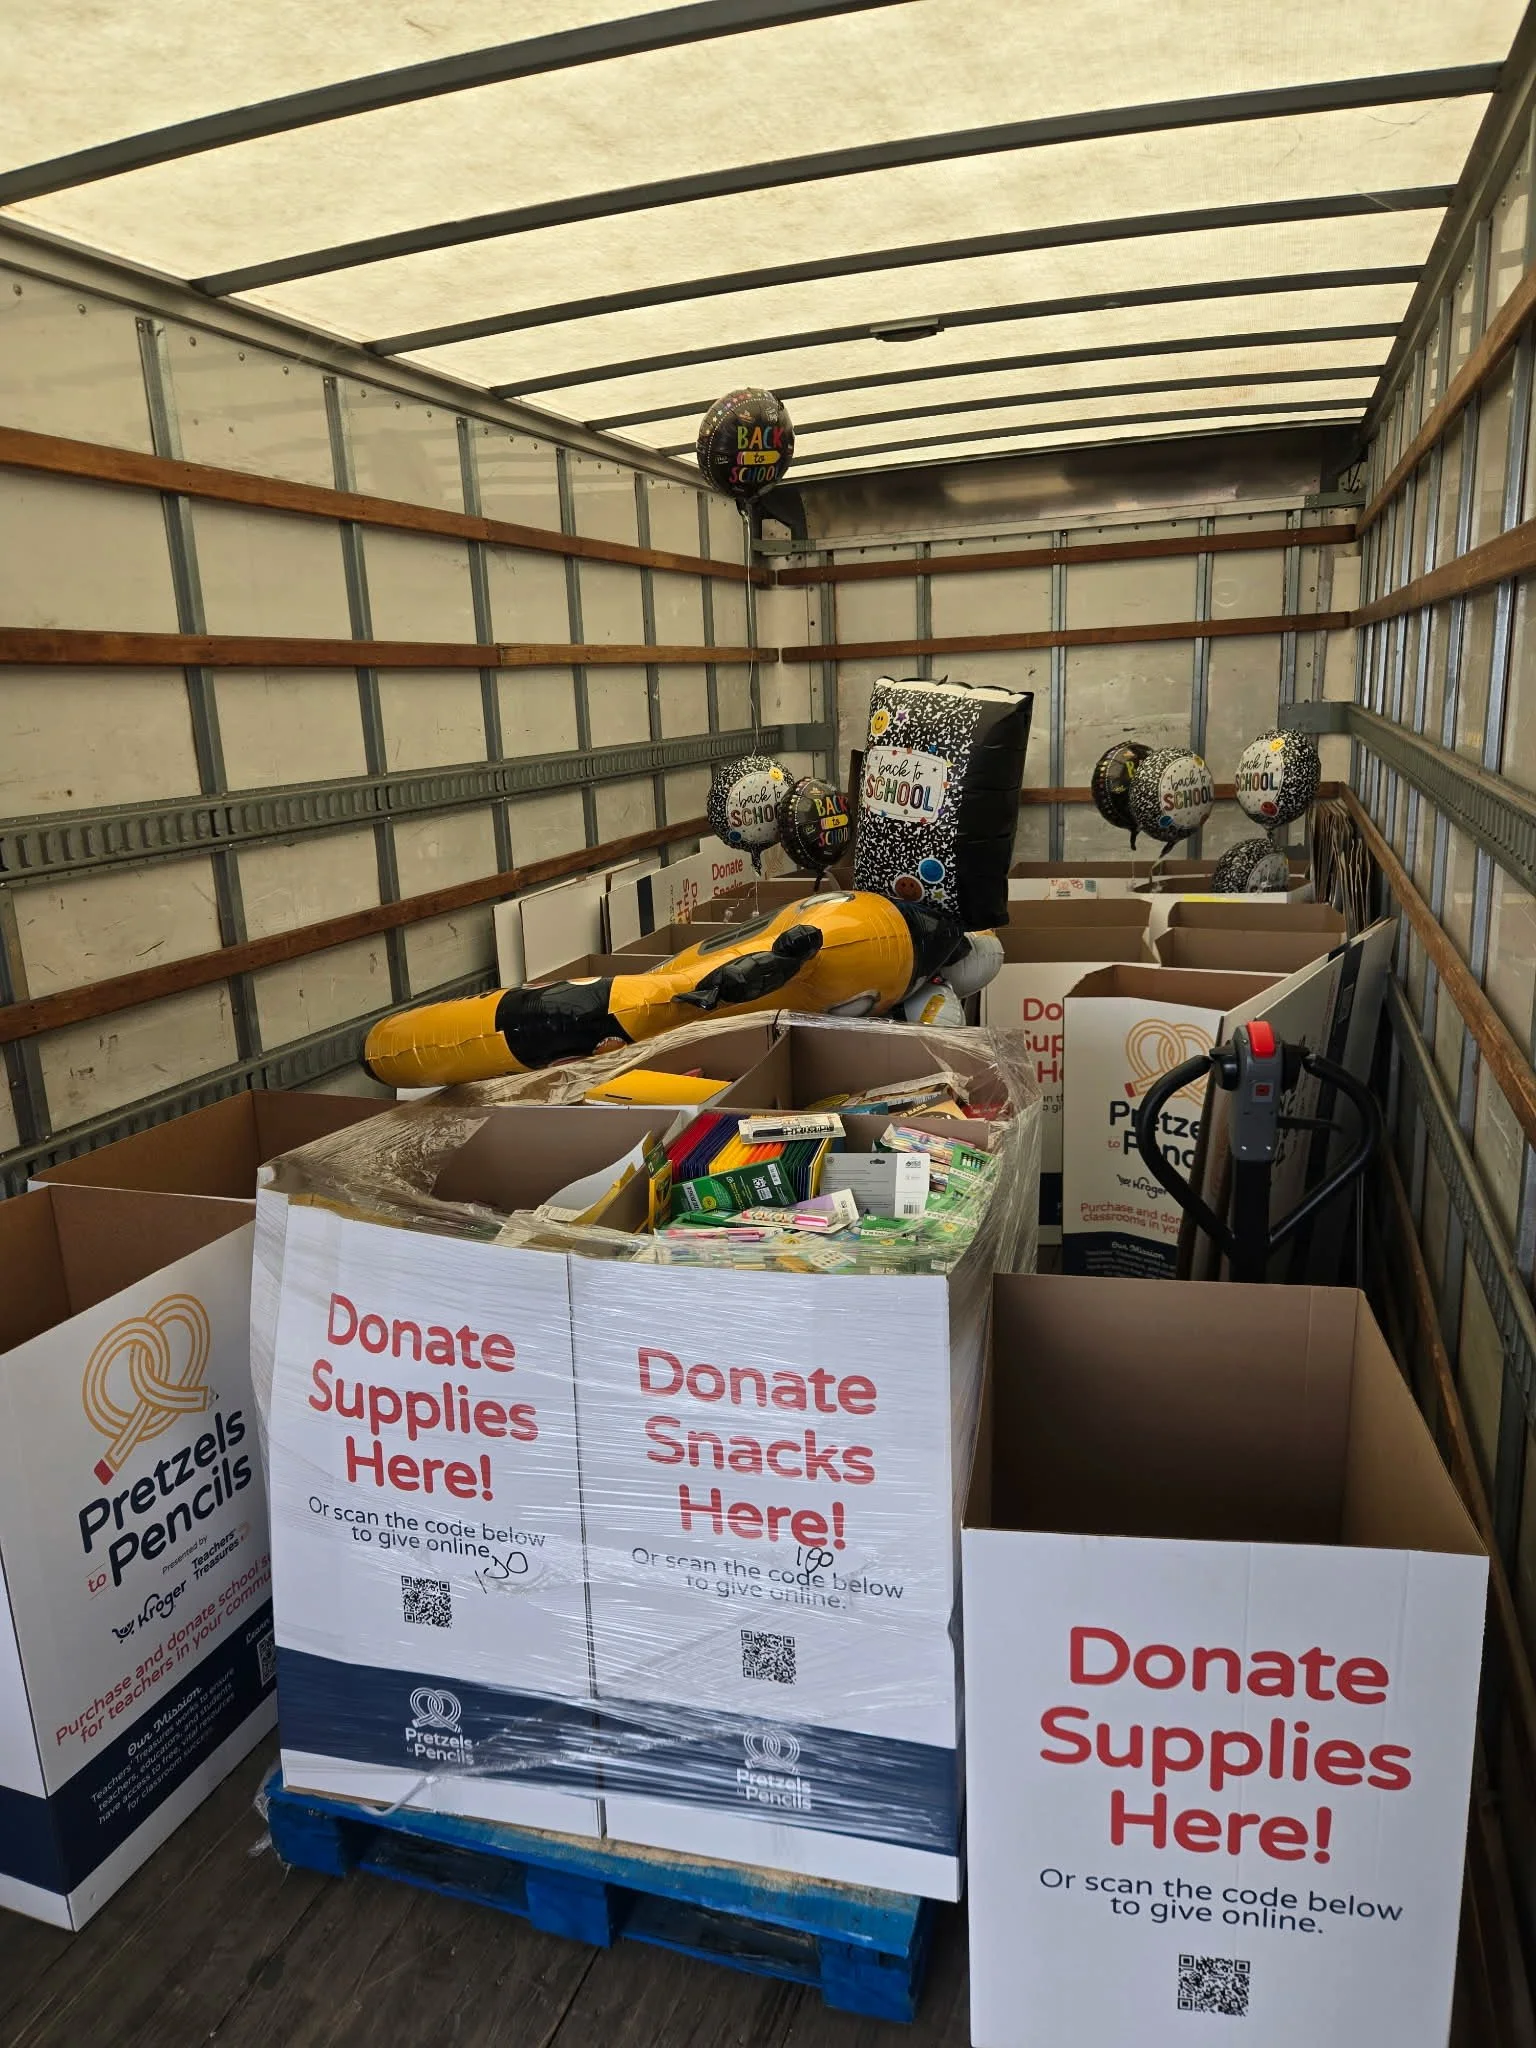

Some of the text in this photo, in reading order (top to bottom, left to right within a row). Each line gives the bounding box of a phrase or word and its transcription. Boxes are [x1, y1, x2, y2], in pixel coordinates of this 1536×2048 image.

[737, 425, 784, 450] BACK
[754, 452, 765, 464] to
[866, 774, 934, 813] SCHOOL
[878, 755, 924, 783] back to
[1235, 772, 1279, 792] SCHOOL
[738, 785, 772, 809] back
[814, 793, 848, 817] BACK
[712, 858, 744, 881] Donate
[1081, 1202, 1134, 1214] Purchase
[1137, 1208, 1158, 1220] and
[1149, 1221, 1159, 1230] in
[327, 1292, 516, 1373] Donate
[308, 1358, 539, 1442] Supplies
[637, 1346, 878, 1415] Donate
[345, 1435, 494, 1502] Here!
[645, 1415, 877, 1485] Snacks
[78, 1410, 246, 1554] Pretzels
[87, 1454, 252, 1593] to Pencils
[308, 1495, 546, 1548] Or scan the code below
[352, 1526, 372, 1542] to
[378, 1529, 420, 1549] give
[679, 1484, 846, 1550] Here!
[162, 1535, 208, 1576] Presented by
[193, 1538, 239, 1581] Treasures
[631, 1547, 904, 1600] Or scan the code below
[138, 1579, 187, 1629] Kroger
[685, 1573, 847, 1610] to give online.
[55, 1560, 258, 1747] Purchase and donate school
[80, 1714, 105, 1744] for
[107, 1658, 174, 1720] teachers
[176, 1643, 190, 1662] in
[192, 1612, 223, 1651] your
[1069, 1626, 1390, 1705] Donate
[127, 1686, 203, 1757] Our Mission
[134, 1725, 175, 1762] Treasures
[175, 1702, 200, 1726] works
[183, 1715, 199, 1731] and
[405, 1727, 473, 1750] Pretzels
[414, 1743, 475, 1766] Pencils
[1039, 1705, 1412, 1792] Supplies
[99, 1802, 121, 1824] have
[122, 1773, 151, 1804] access
[151, 1764, 161, 1775] to
[127, 1795, 141, 1813] for
[141, 1755, 182, 1797] classroom
[736, 1768, 812, 1793] Pretzels
[745, 1785, 812, 1810] Pencils
[1110, 1789, 1332, 1864] Here!
[1039, 1868, 1403, 1922] Or scan the code below
[1111, 1896, 1324, 1934] to give online.
